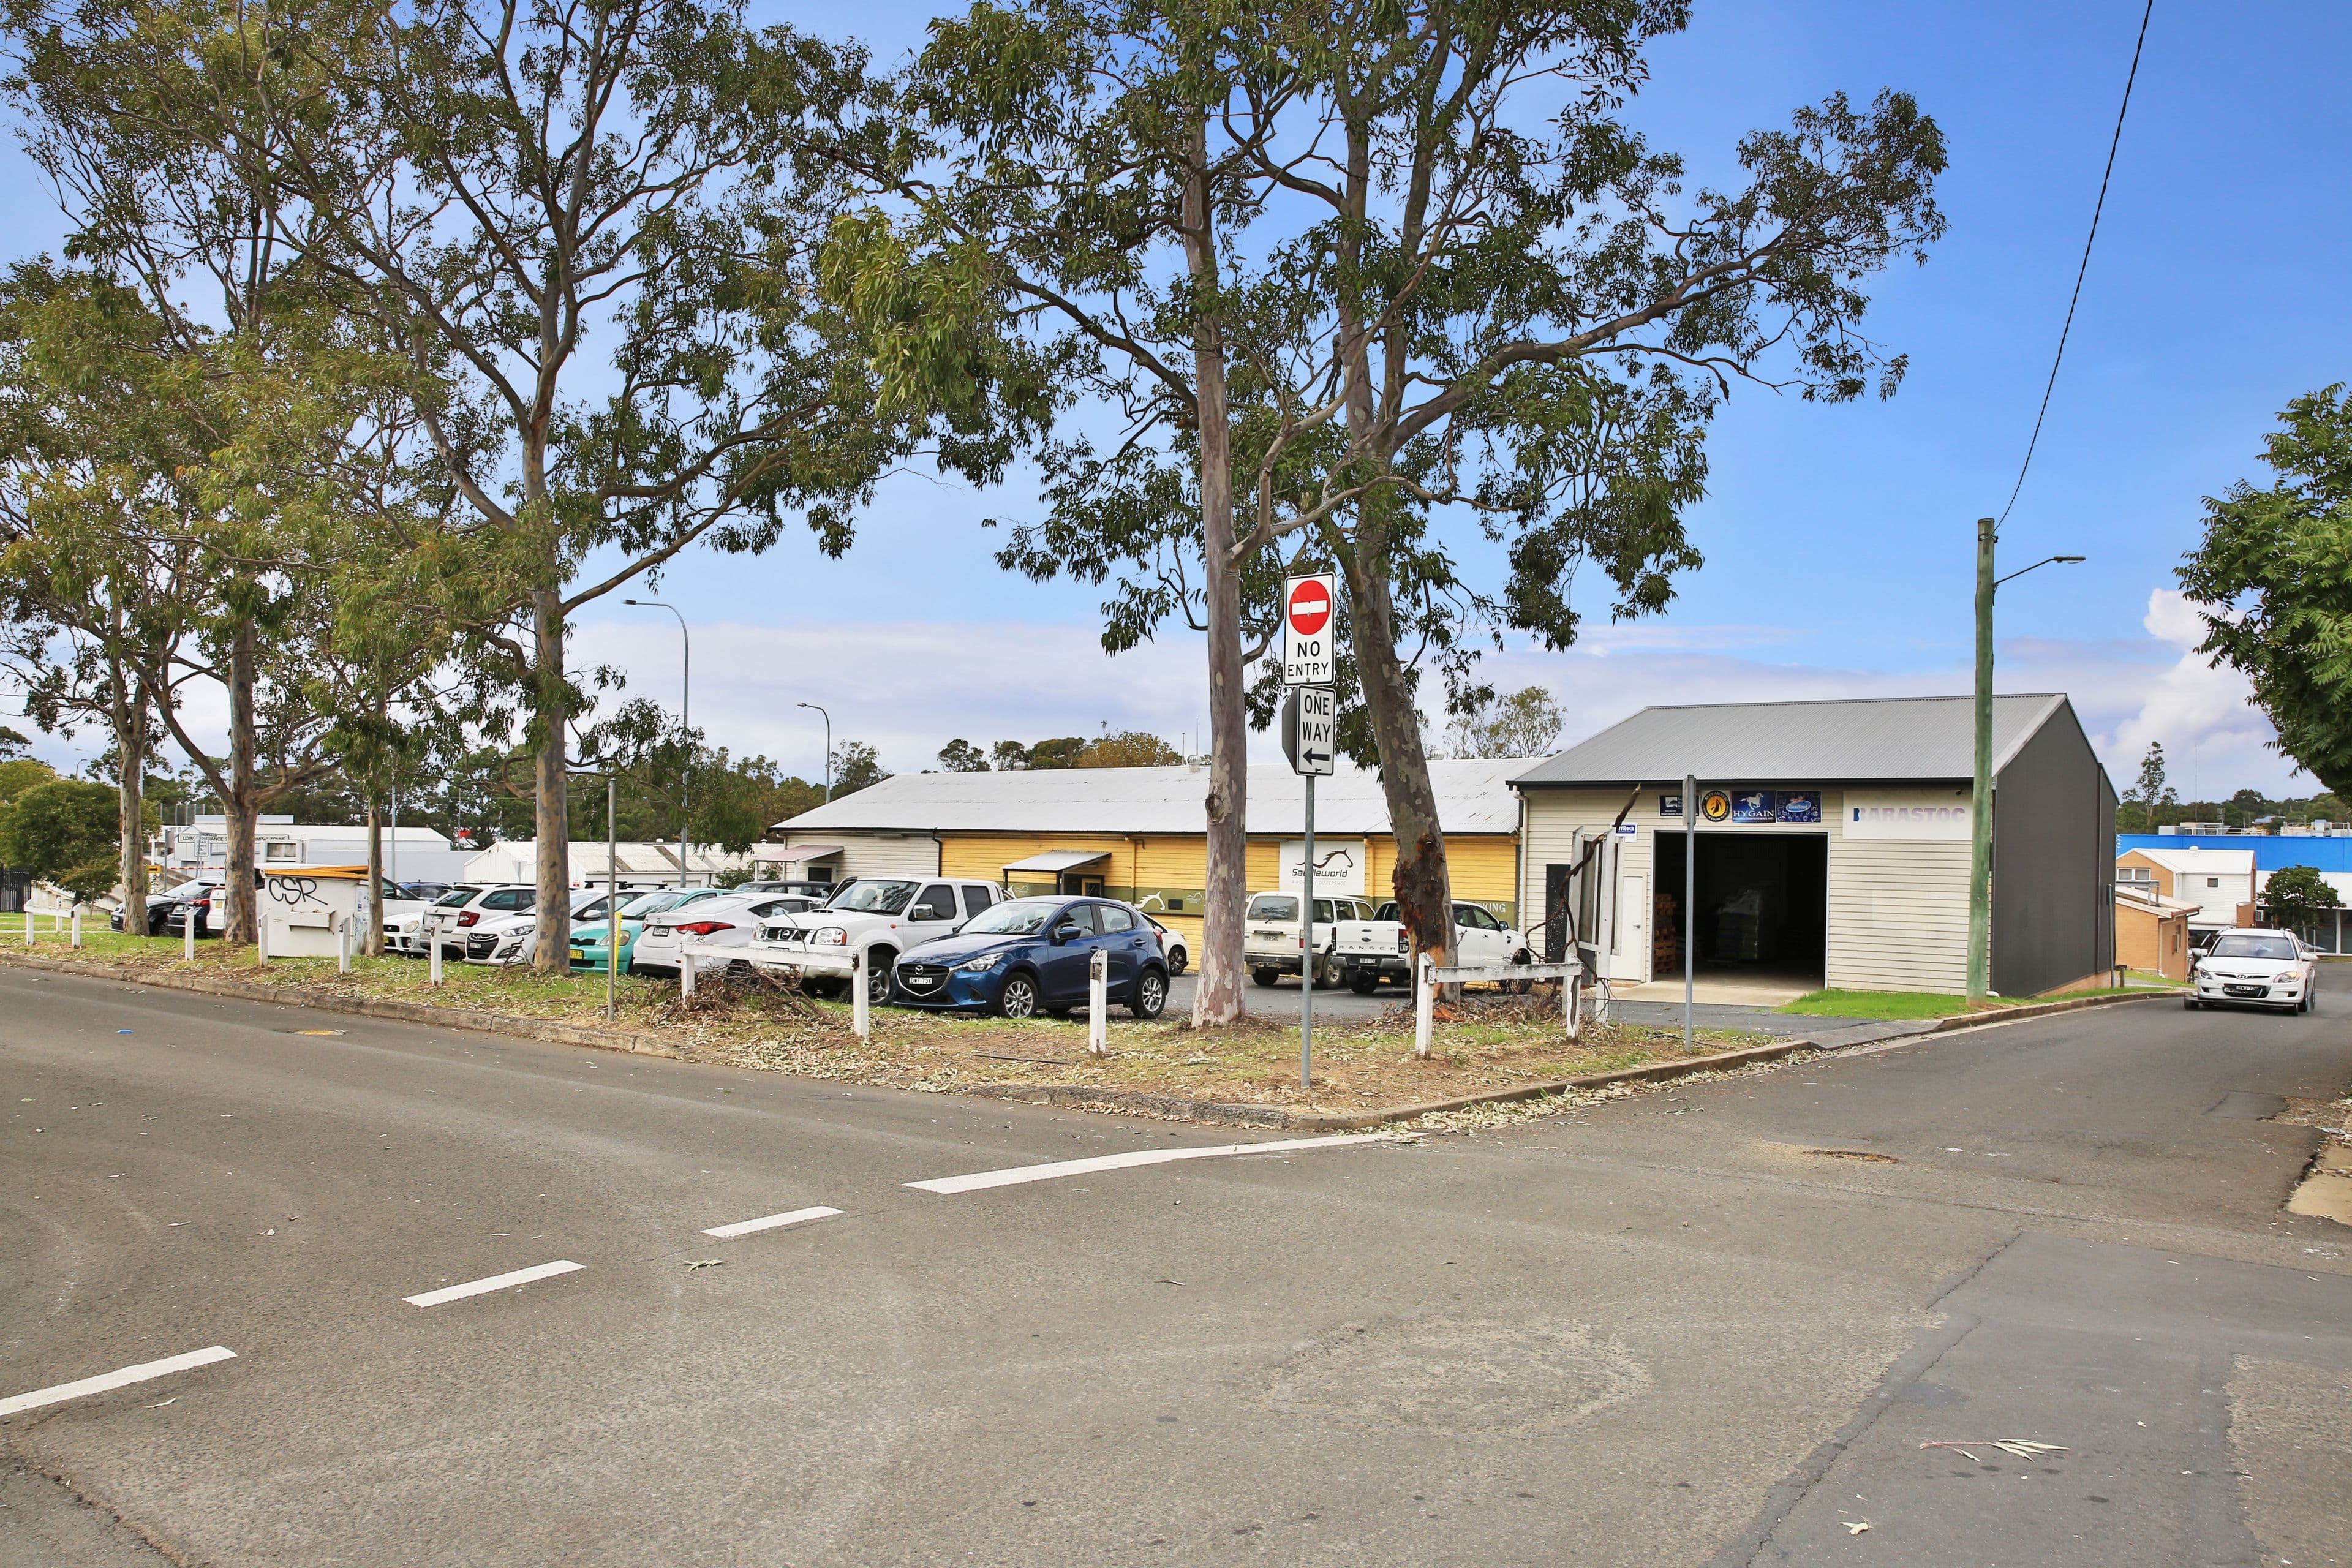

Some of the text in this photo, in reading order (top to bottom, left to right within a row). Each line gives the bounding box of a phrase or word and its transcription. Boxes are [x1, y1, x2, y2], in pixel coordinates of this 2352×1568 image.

[1297, 641, 1320, 657] NO
[1288, 662, 1329, 676] ENTRY
[1305, 695, 1329, 715] ONE
[1303, 722, 1330, 742] WAY
[269, 877, 328, 905] CSR
